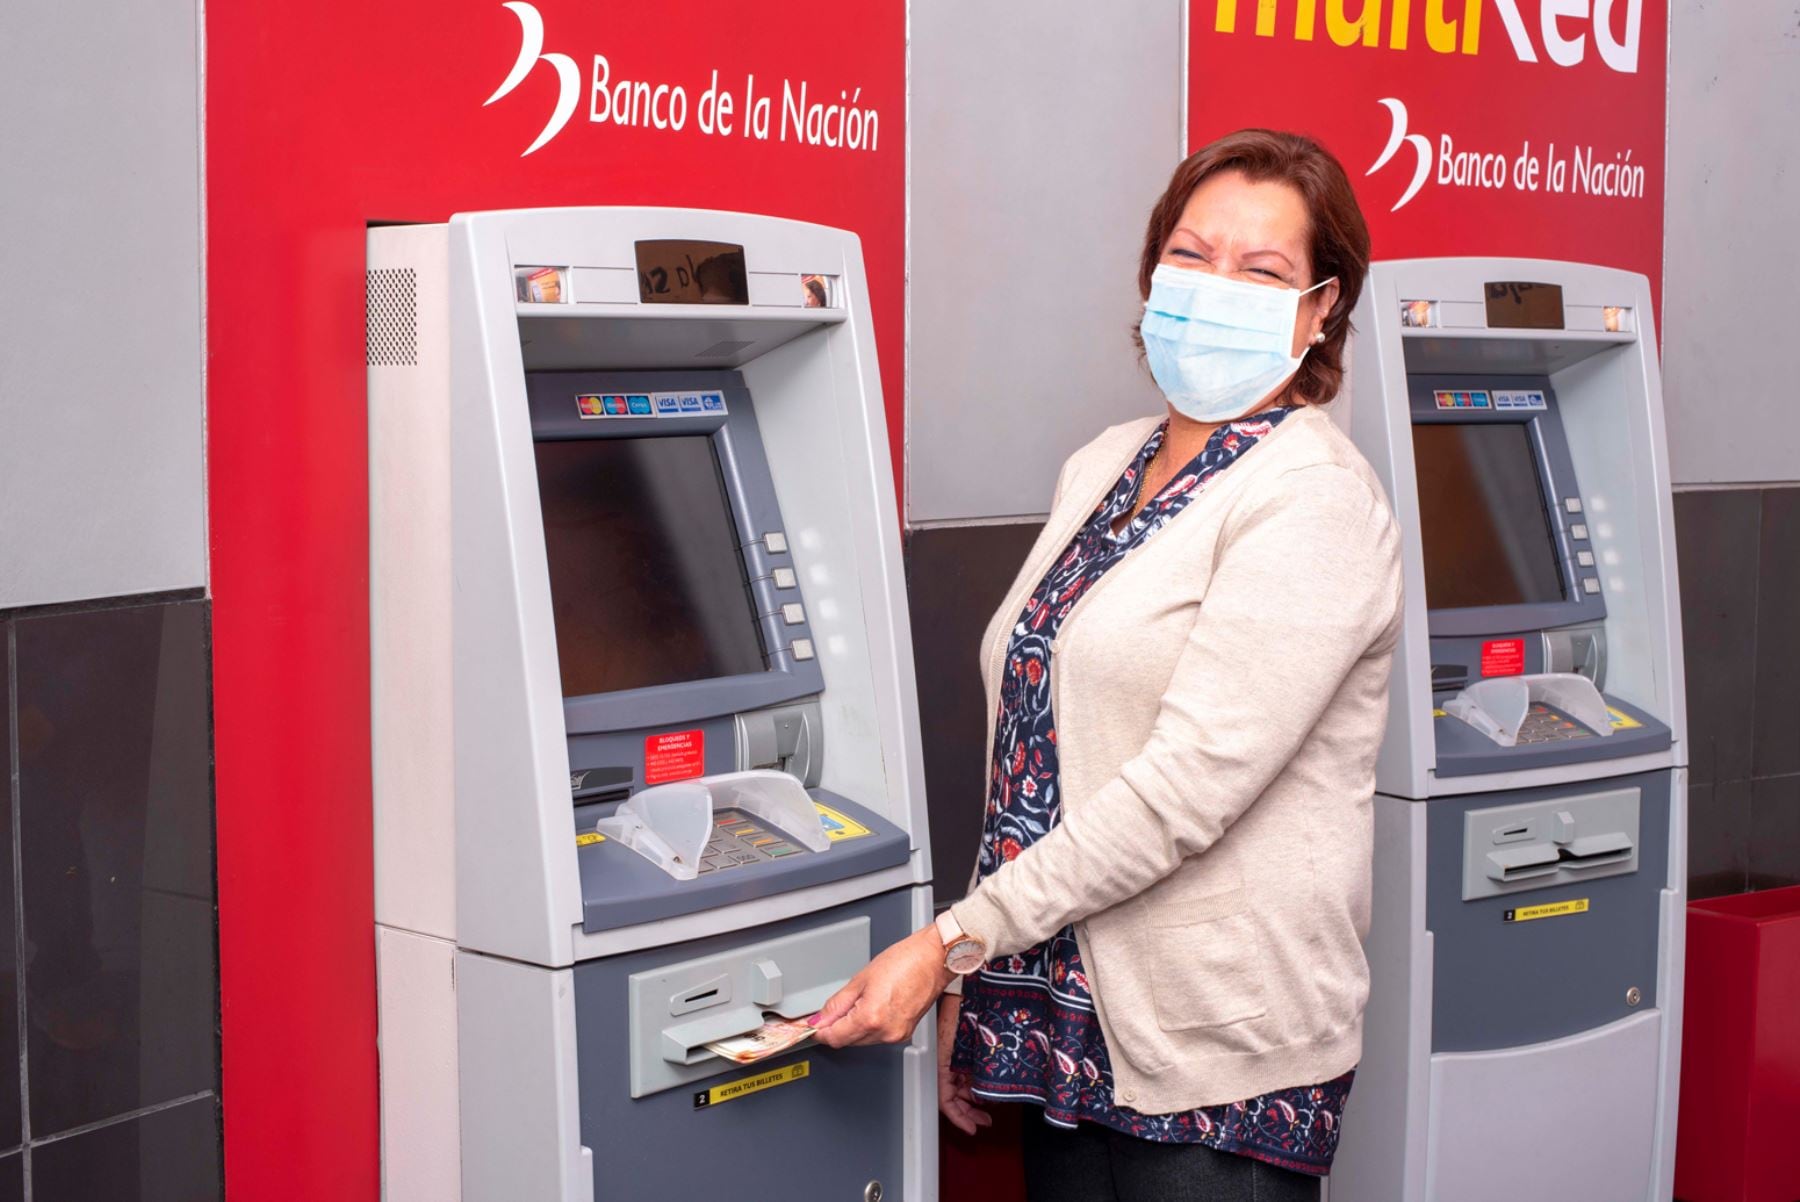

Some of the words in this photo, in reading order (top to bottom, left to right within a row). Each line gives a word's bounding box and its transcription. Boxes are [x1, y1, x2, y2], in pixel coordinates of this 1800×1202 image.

[589, 54, 687, 131] Banco
[698, 69, 733, 136] de
[744, 74, 771, 140] la
[780, 79, 879, 151] Nación
[1437, 133, 1506, 189] Banco
[1513, 141, 1539, 191] de
[1546, 143, 1566, 193] la
[1571, 145, 1645, 198] Nación
[658, 398, 676, 407] VISA
[681, 396, 699, 406] VISA
[699, 1094, 706, 1104] 2
[720, 1086, 742, 1097] RETIRA
[743, 1081, 756, 1090] TUS
[756, 1073, 784, 1086] BILLETES
